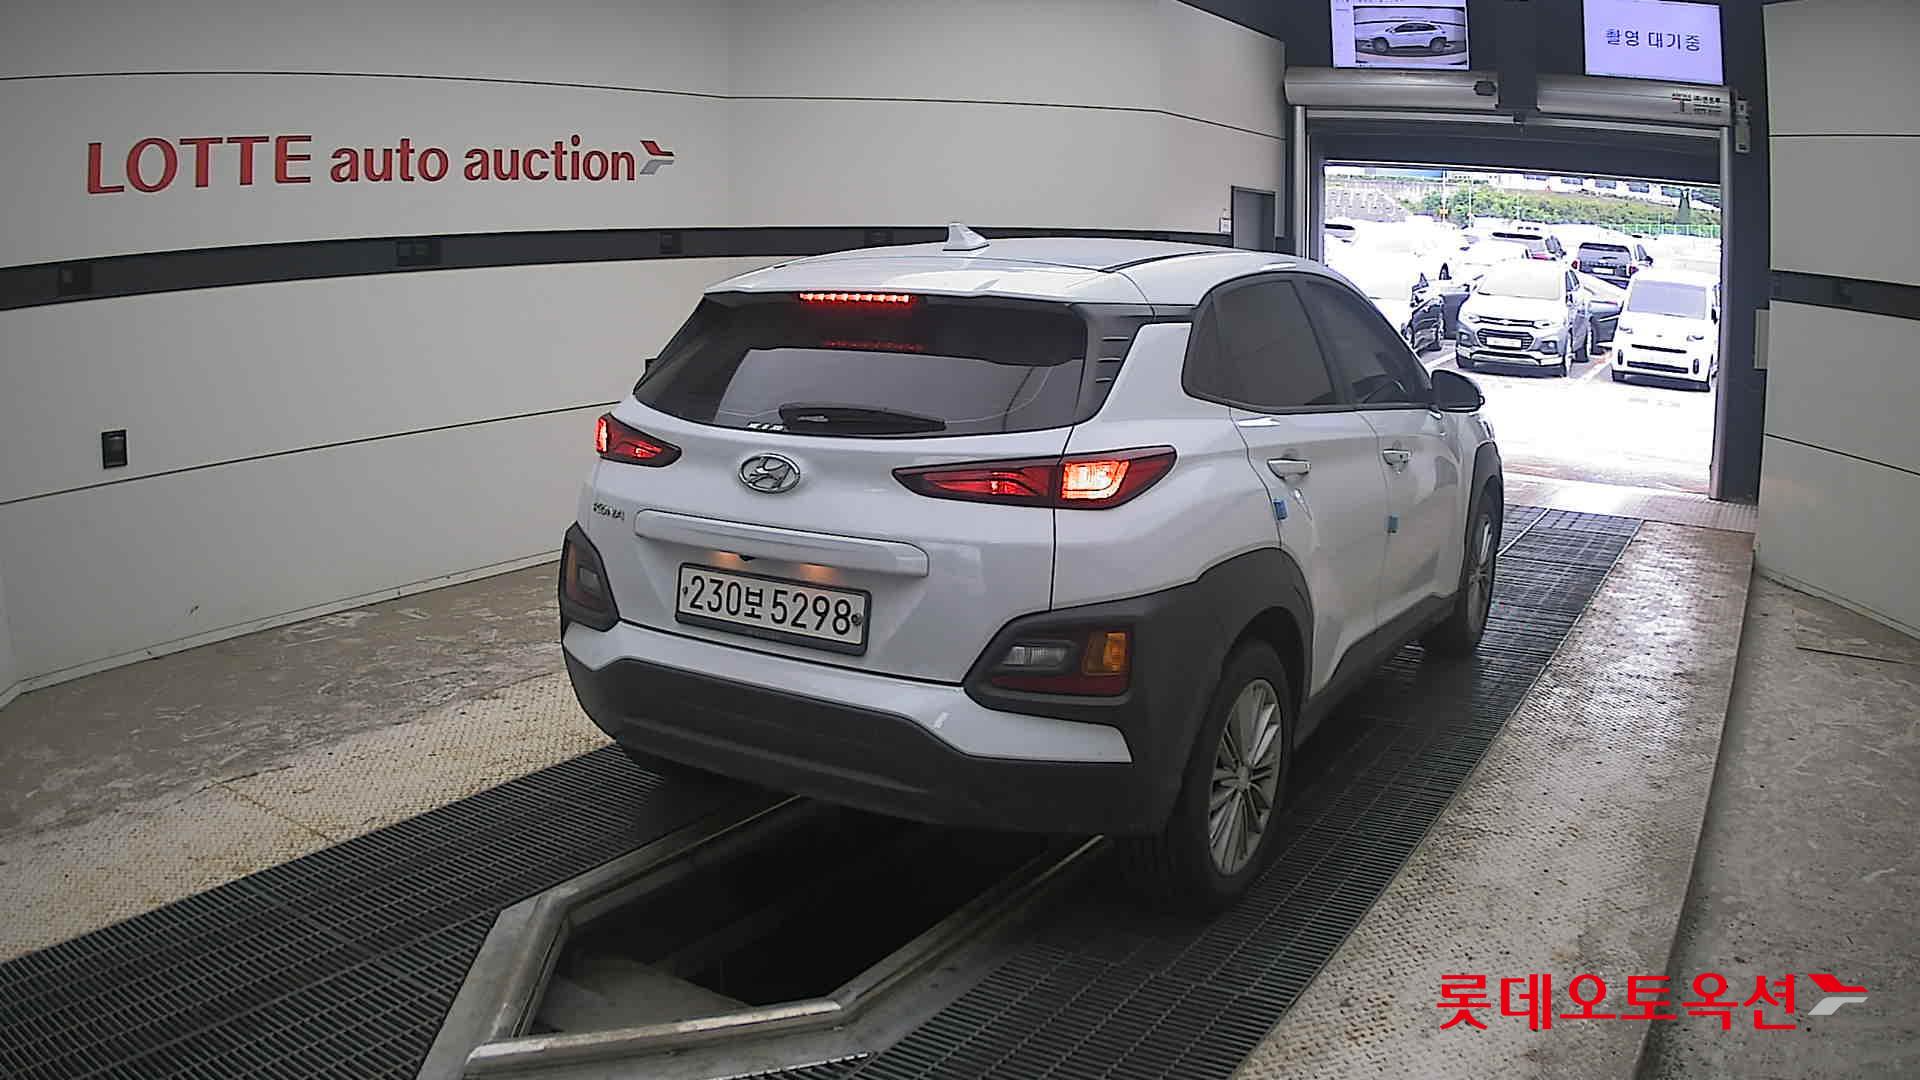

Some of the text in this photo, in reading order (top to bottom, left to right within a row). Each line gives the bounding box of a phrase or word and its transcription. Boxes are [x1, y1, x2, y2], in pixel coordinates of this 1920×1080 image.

[1606, 29, 1640, 47] 촬영
[87, 134, 635, 194] LOTTE auto auction
